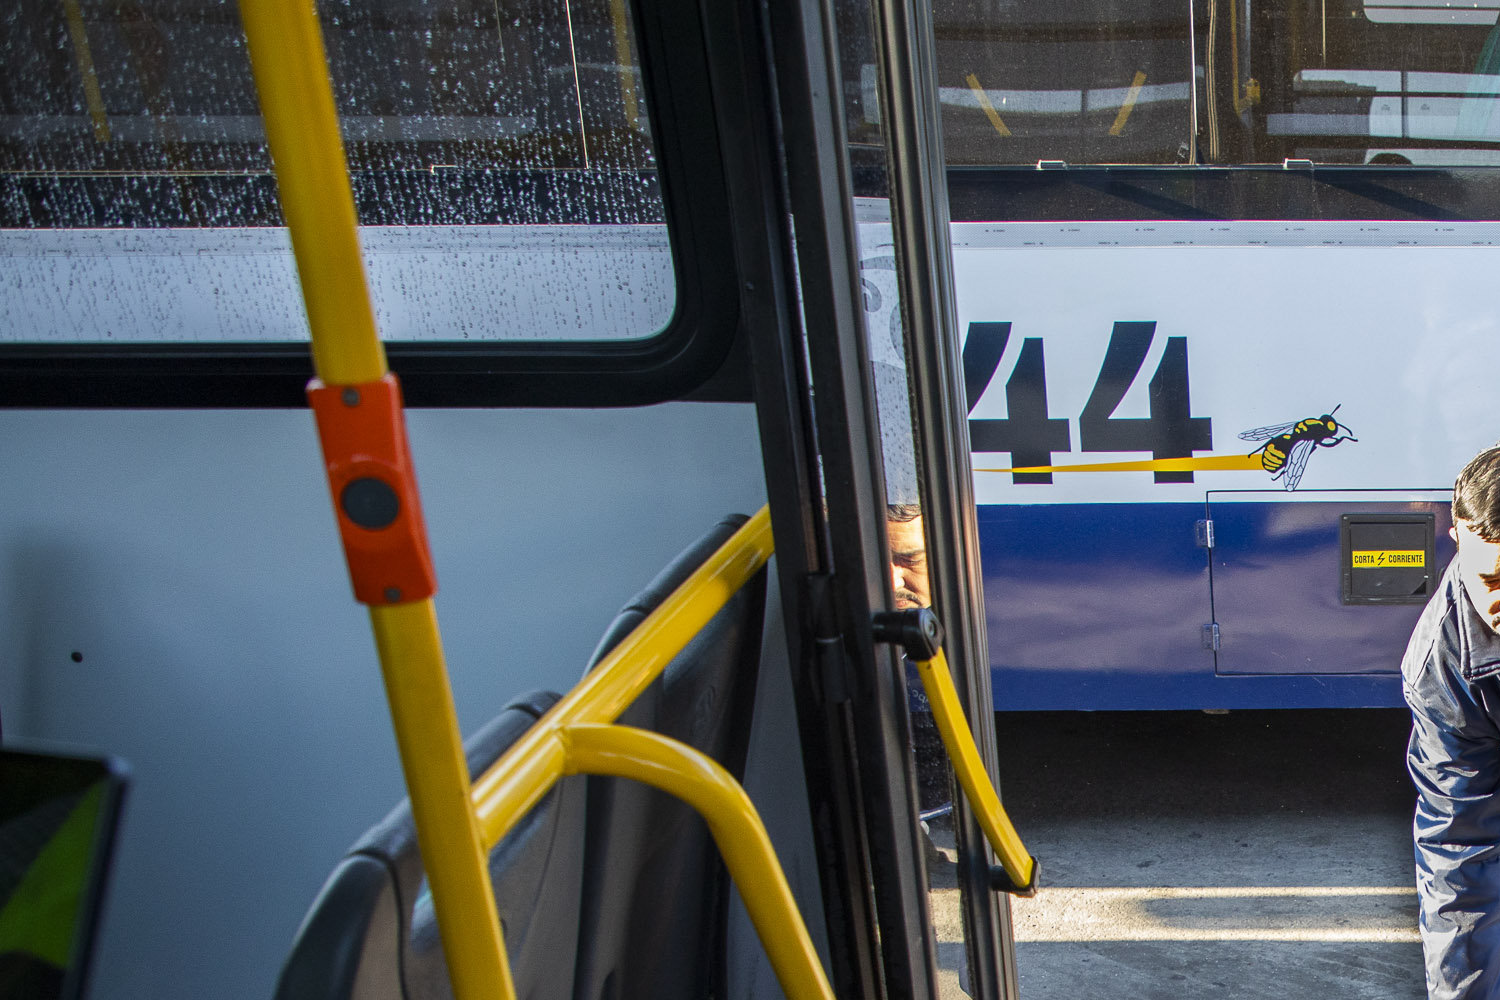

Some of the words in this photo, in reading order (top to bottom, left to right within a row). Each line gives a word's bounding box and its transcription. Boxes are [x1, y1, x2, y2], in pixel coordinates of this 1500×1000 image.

[963, 321, 1212, 484] 44
[1354, 555, 1375, 564] CORTA
[1388, 554, 1423, 563] CORRIENTE
